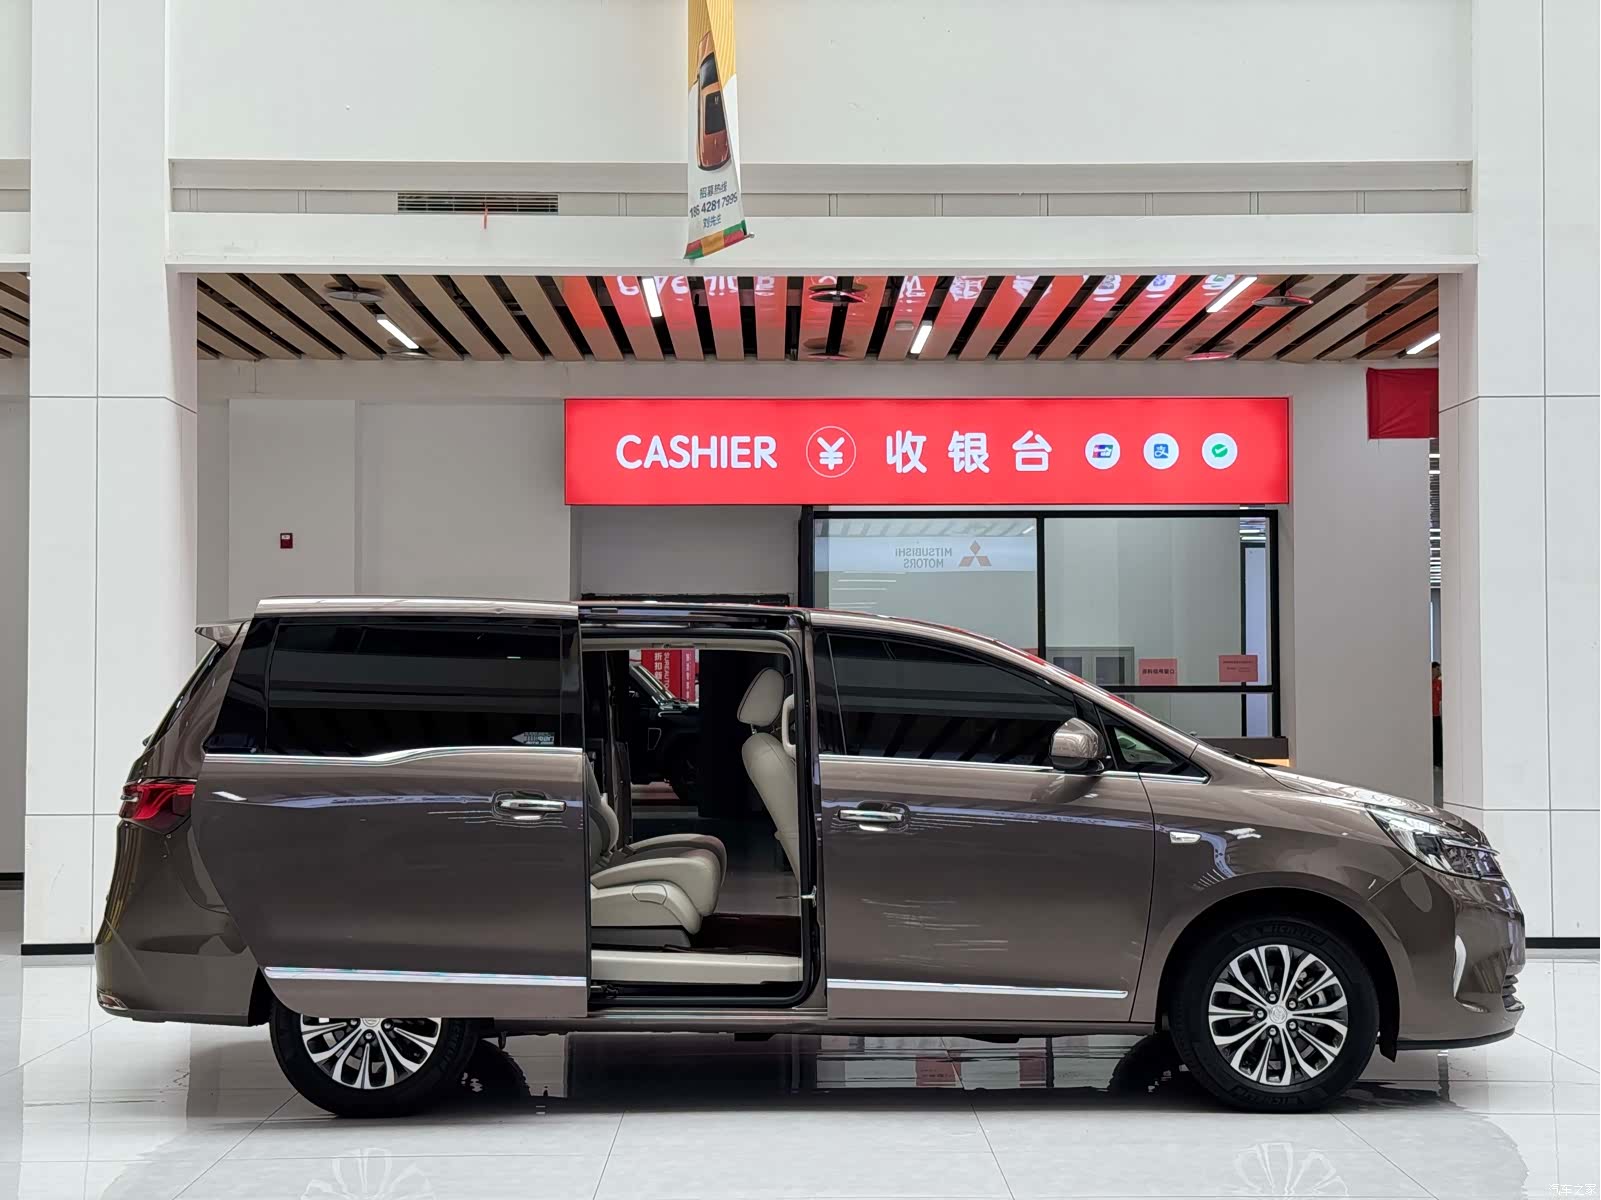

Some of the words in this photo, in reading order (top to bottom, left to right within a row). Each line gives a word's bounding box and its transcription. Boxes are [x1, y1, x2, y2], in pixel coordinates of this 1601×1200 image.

[701, 199, 721, 213] 4281
[615, 434, 778, 470] CASHIER
[886, 430, 1052, 473] 收银台
